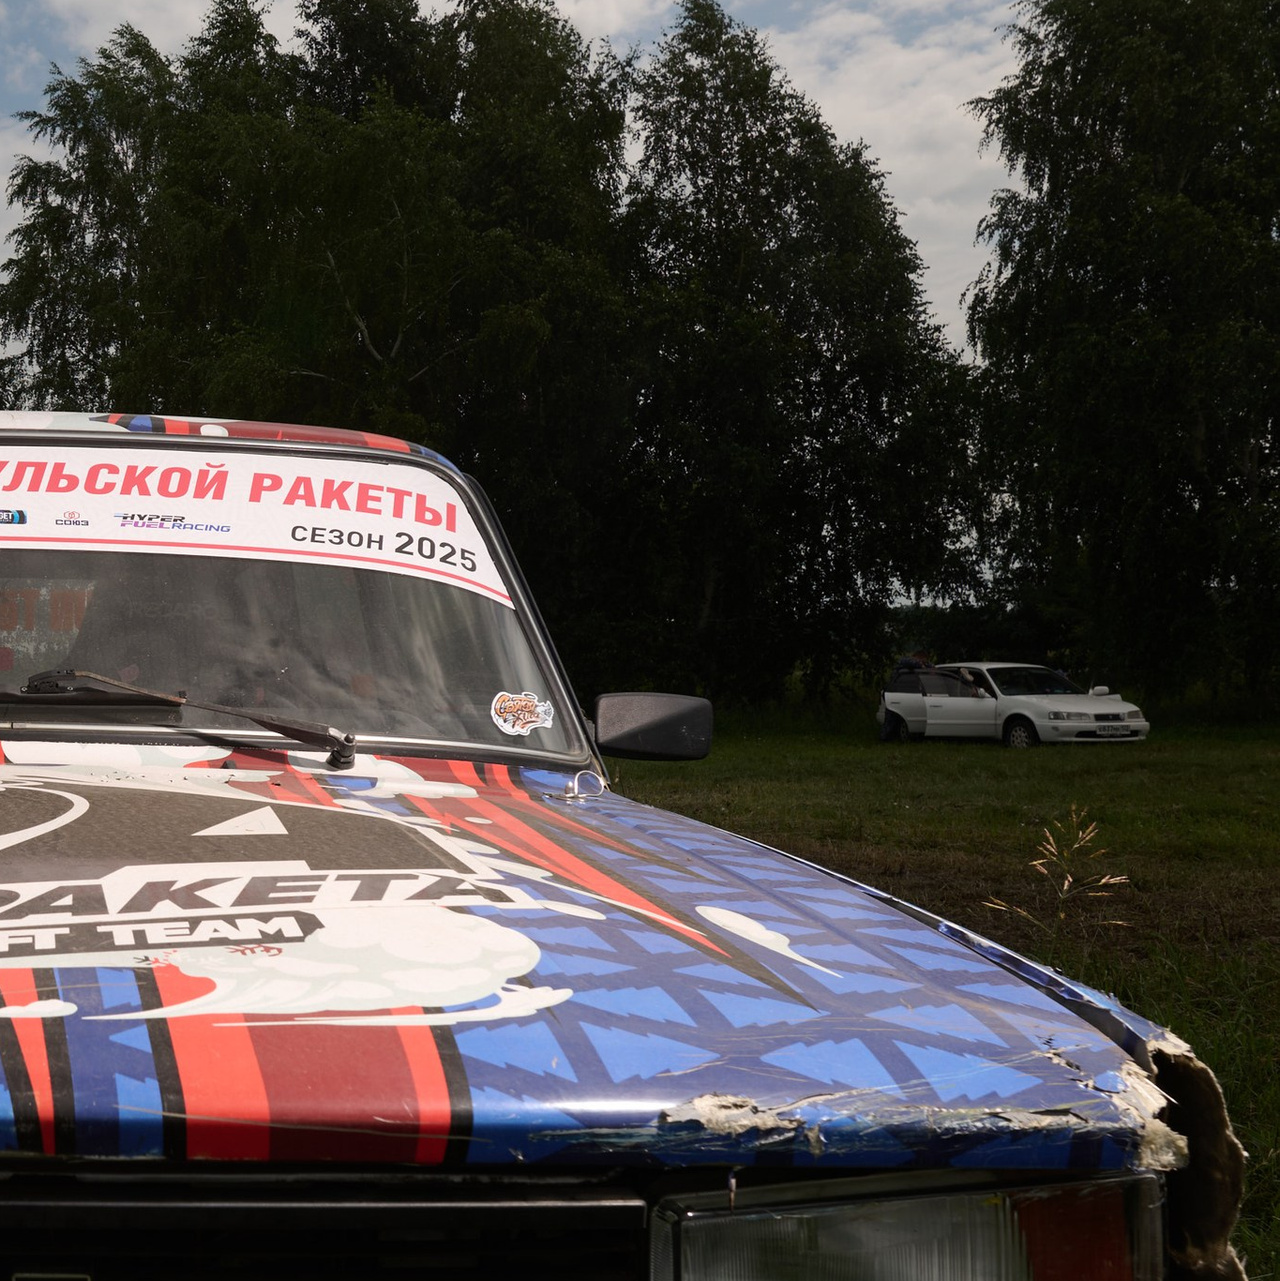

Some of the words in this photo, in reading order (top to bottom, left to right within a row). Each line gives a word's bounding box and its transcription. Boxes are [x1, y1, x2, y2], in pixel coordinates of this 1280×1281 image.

[249, 472, 458, 533] РАКЕТЫ
[55, 519, 89, 527] СОЮЗ
[120, 513, 186, 523] HYPER
[290, 525, 384, 551] СЕЗОН
[394, 531, 478, 573] 2025
[97, 916, 302, 946] TEAM
